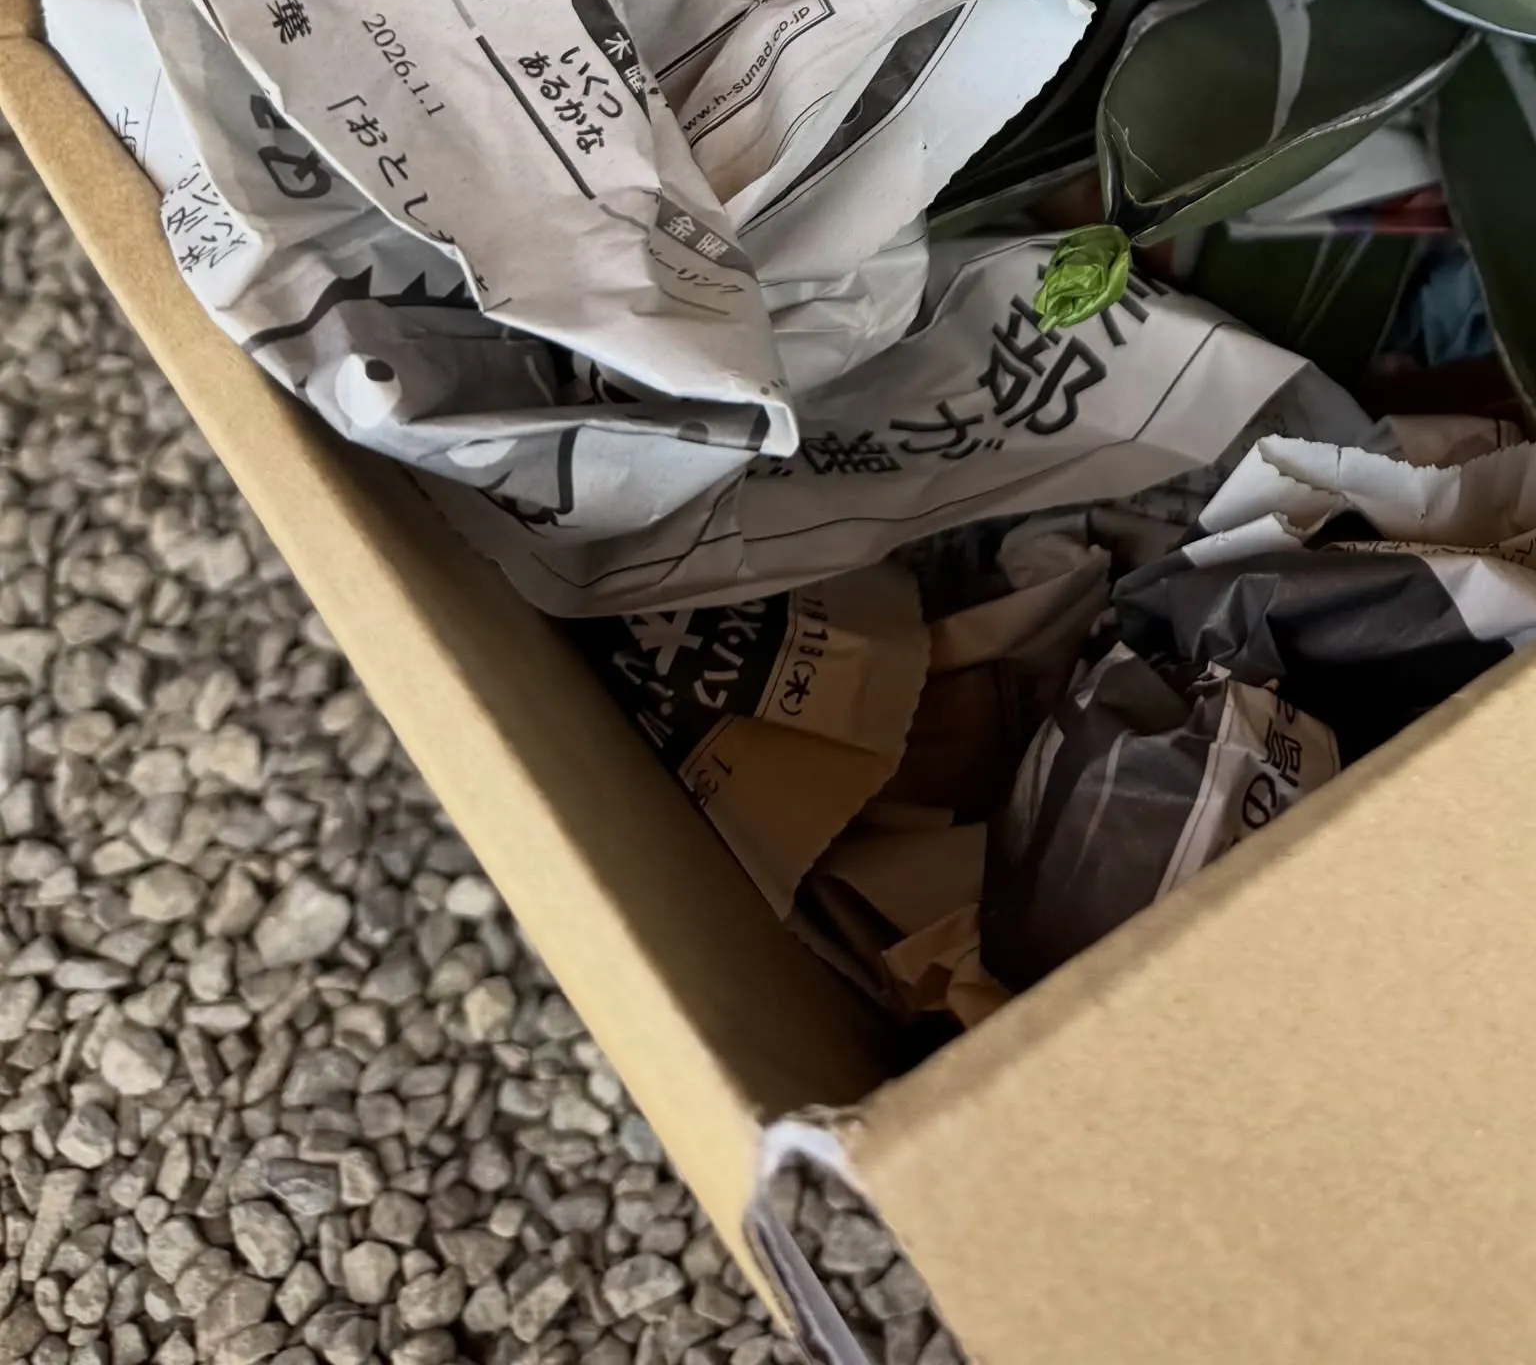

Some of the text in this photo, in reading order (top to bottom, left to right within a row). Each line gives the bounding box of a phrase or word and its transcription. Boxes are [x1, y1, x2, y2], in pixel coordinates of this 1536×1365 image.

[361, 13, 447, 117] 2026.1.1
[560, 46, 623, 118] いくつ
[600, 32, 646, 93] 木曜
[518, 51, 604, 154] あるかな
[664, 215, 729, 260] 金曜
